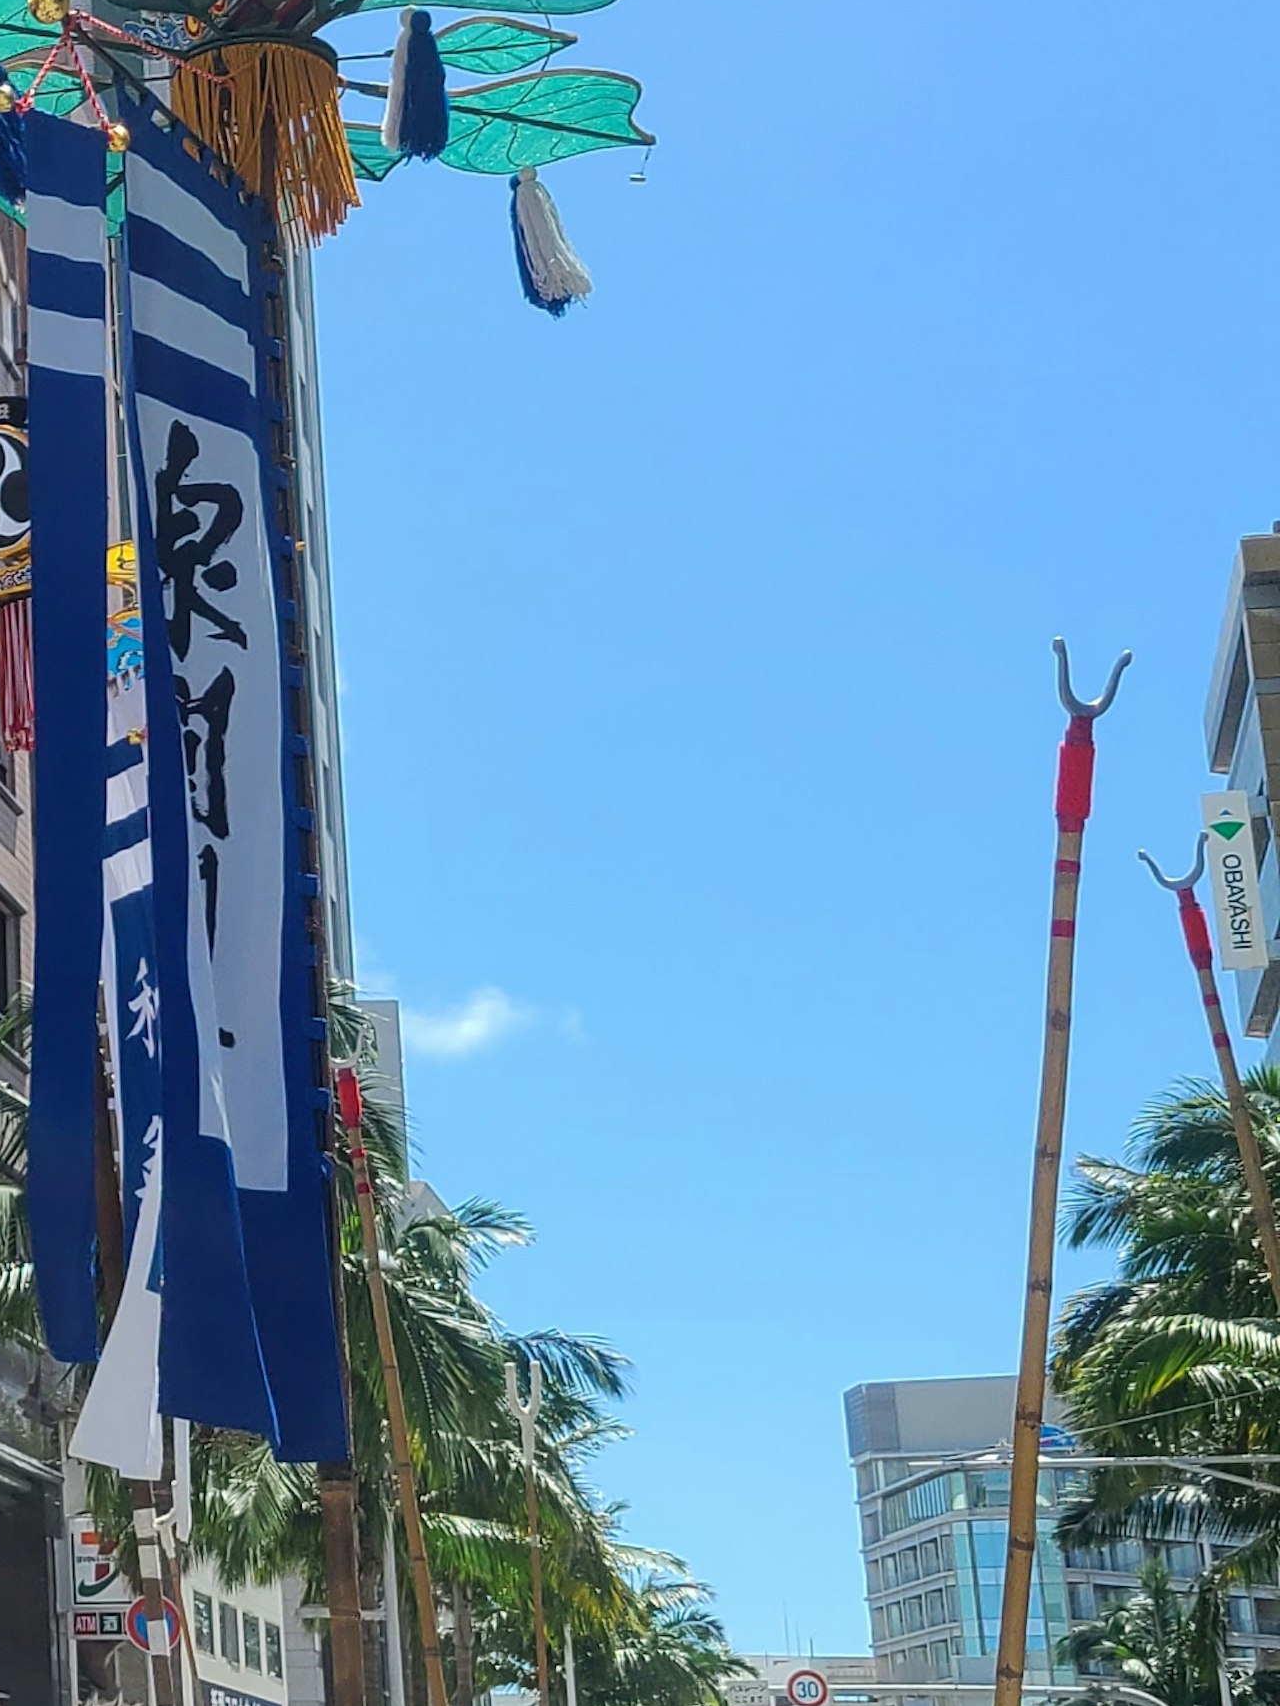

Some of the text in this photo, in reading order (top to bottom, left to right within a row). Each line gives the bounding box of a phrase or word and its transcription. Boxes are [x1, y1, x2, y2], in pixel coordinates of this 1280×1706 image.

[1222, 854, 1252, 952] OBAYASHI
[76, 1615, 96, 1631] ATM
[730, 1684, 767, 1693] バスレーン
[796, 1681, 819, 1698] 30
[735, 1695, 764, 1704] ここまで
